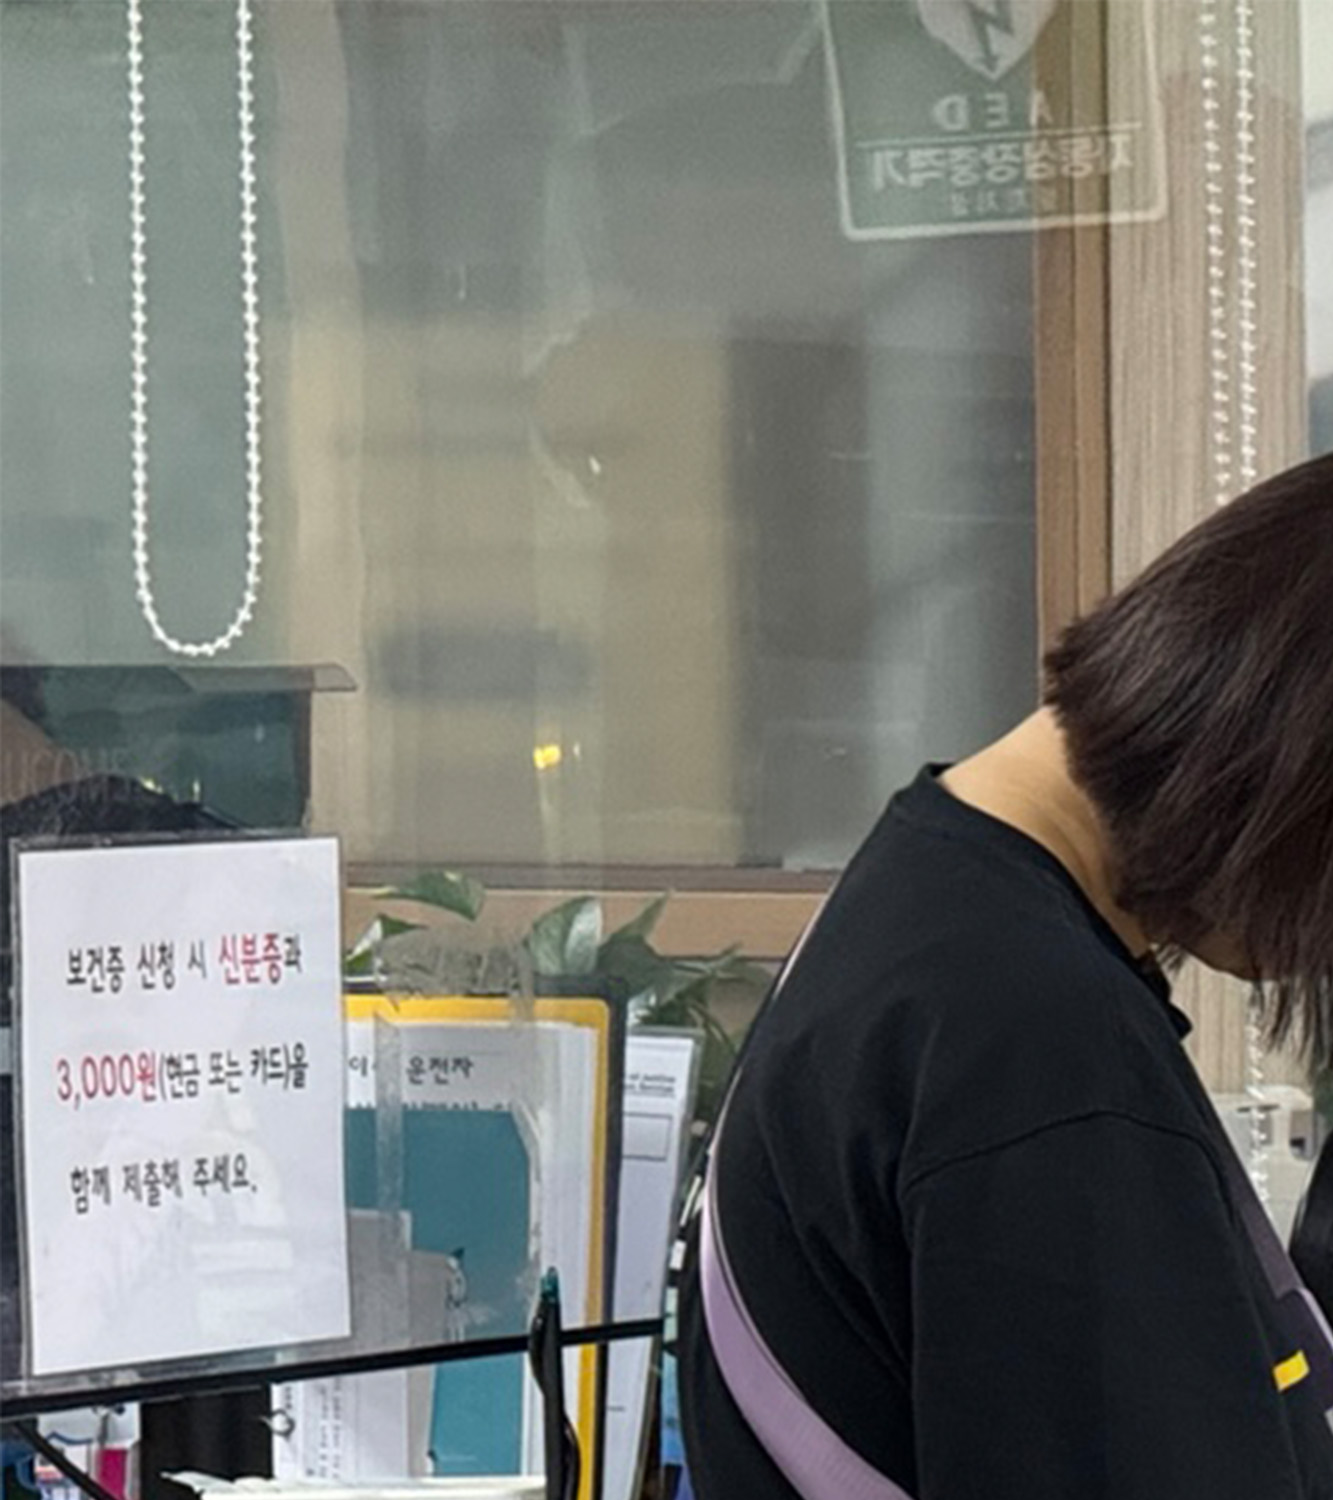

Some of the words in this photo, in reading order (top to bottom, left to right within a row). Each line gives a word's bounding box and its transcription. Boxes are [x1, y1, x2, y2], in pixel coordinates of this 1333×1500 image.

[66, 945, 125, 994] 보건증
[137, 938, 176, 991] 신청
[187, 939, 208, 979] 시
[218, 933, 303, 985] 신분증과
[56, 1050, 201, 1111] 3,000원(현금
[208, 1051, 243, 1094] 또는
[250, 1042, 309, 1091] 카드)을
[70, 1165, 112, 1216] 함께
[123, 1159, 182, 1208] 제출해
[192, 1151, 259, 1196] 주세요.
